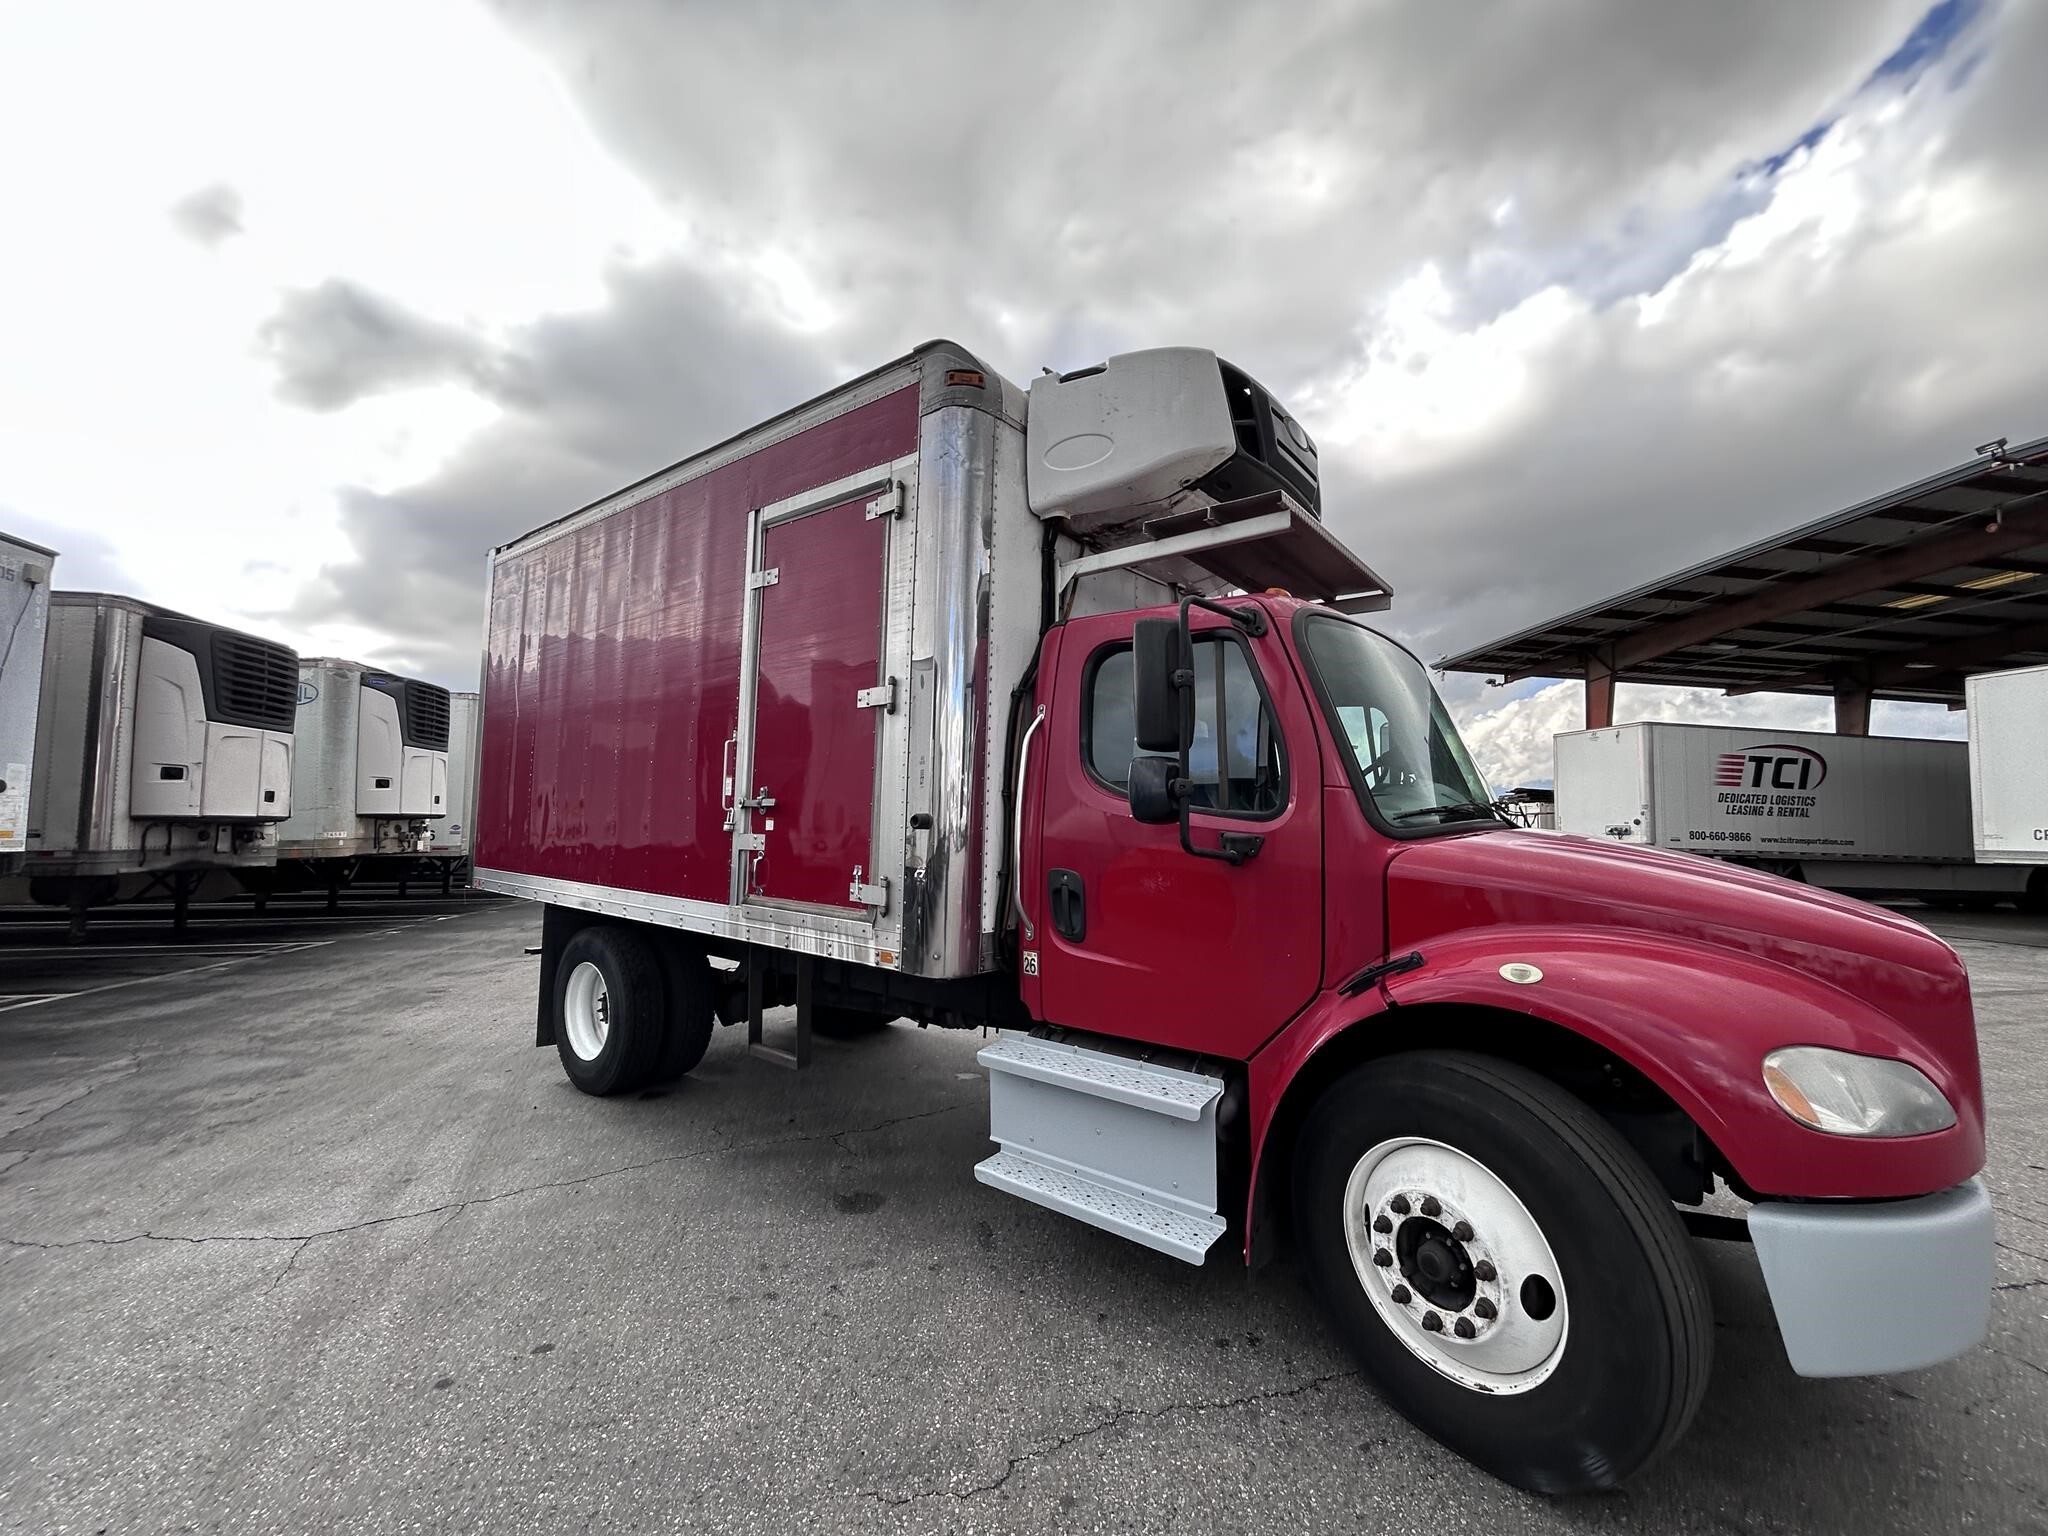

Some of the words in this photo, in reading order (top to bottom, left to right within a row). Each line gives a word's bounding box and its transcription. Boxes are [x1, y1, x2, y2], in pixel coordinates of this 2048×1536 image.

[1747, 755, 1812, 790] TCI
[1718, 793, 1768, 805] DEDICATED
[1769, 794, 1816, 807] LOGISTICS
[1725, 805, 1764, 816] LEASING
[1767, 806, 1774, 817] &
[1776, 806, 1810, 818] RENTAL
[1689, 830, 1752, 842] 800-660-9866
[1760, 835, 1855, 847] www.tcitransportation.com
[1024, 957, 1036, 974] 26
